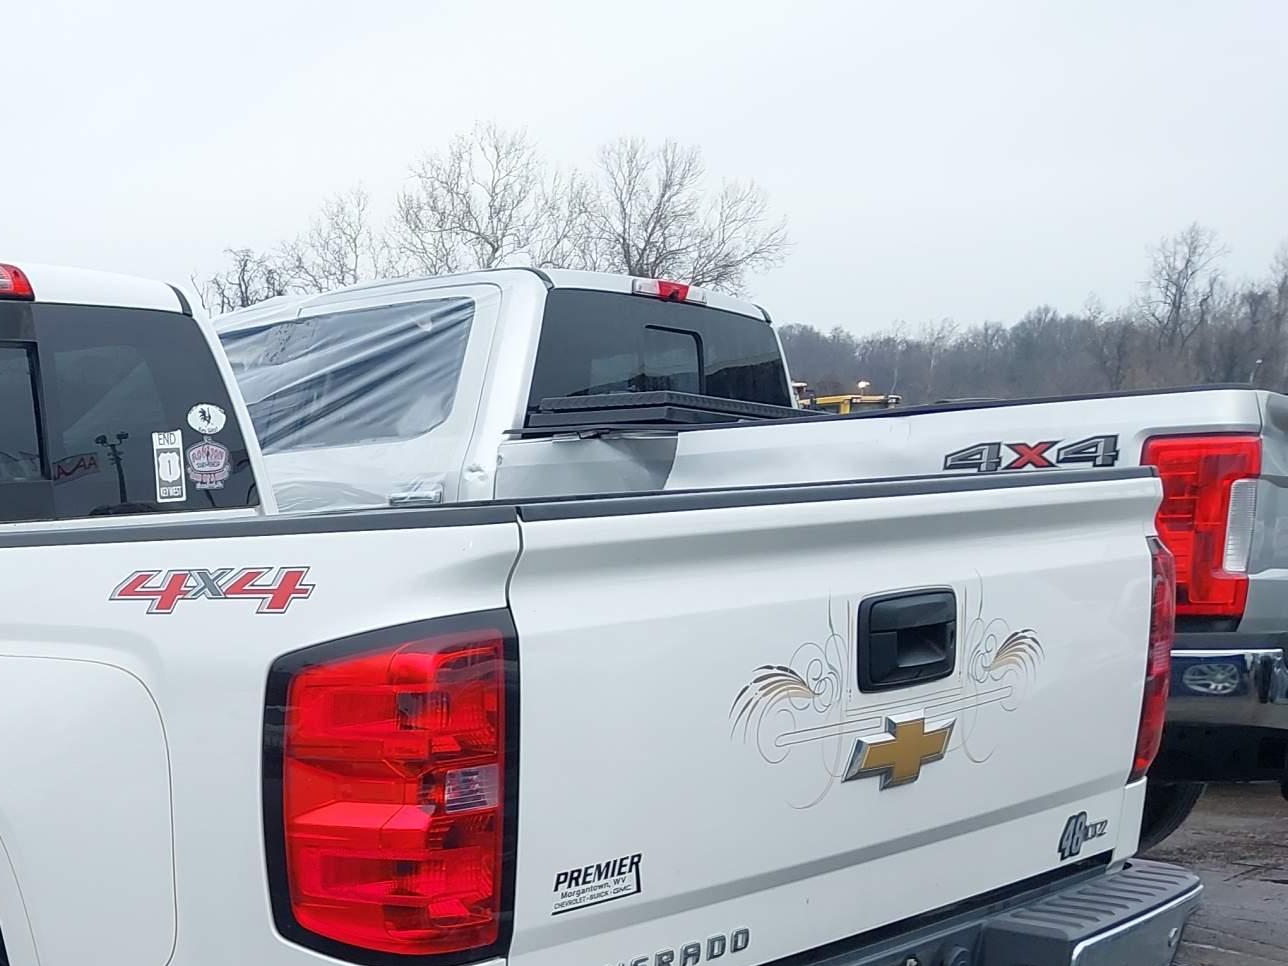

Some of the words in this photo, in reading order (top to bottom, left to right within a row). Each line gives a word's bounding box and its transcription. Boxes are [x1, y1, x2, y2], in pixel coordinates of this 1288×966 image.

[157, 432, 176, 446] END
[553, 853, 642, 893] PREMIER
[561, 882, 612, 900] Morgantown,
[613, 876, 627, 886] WV
